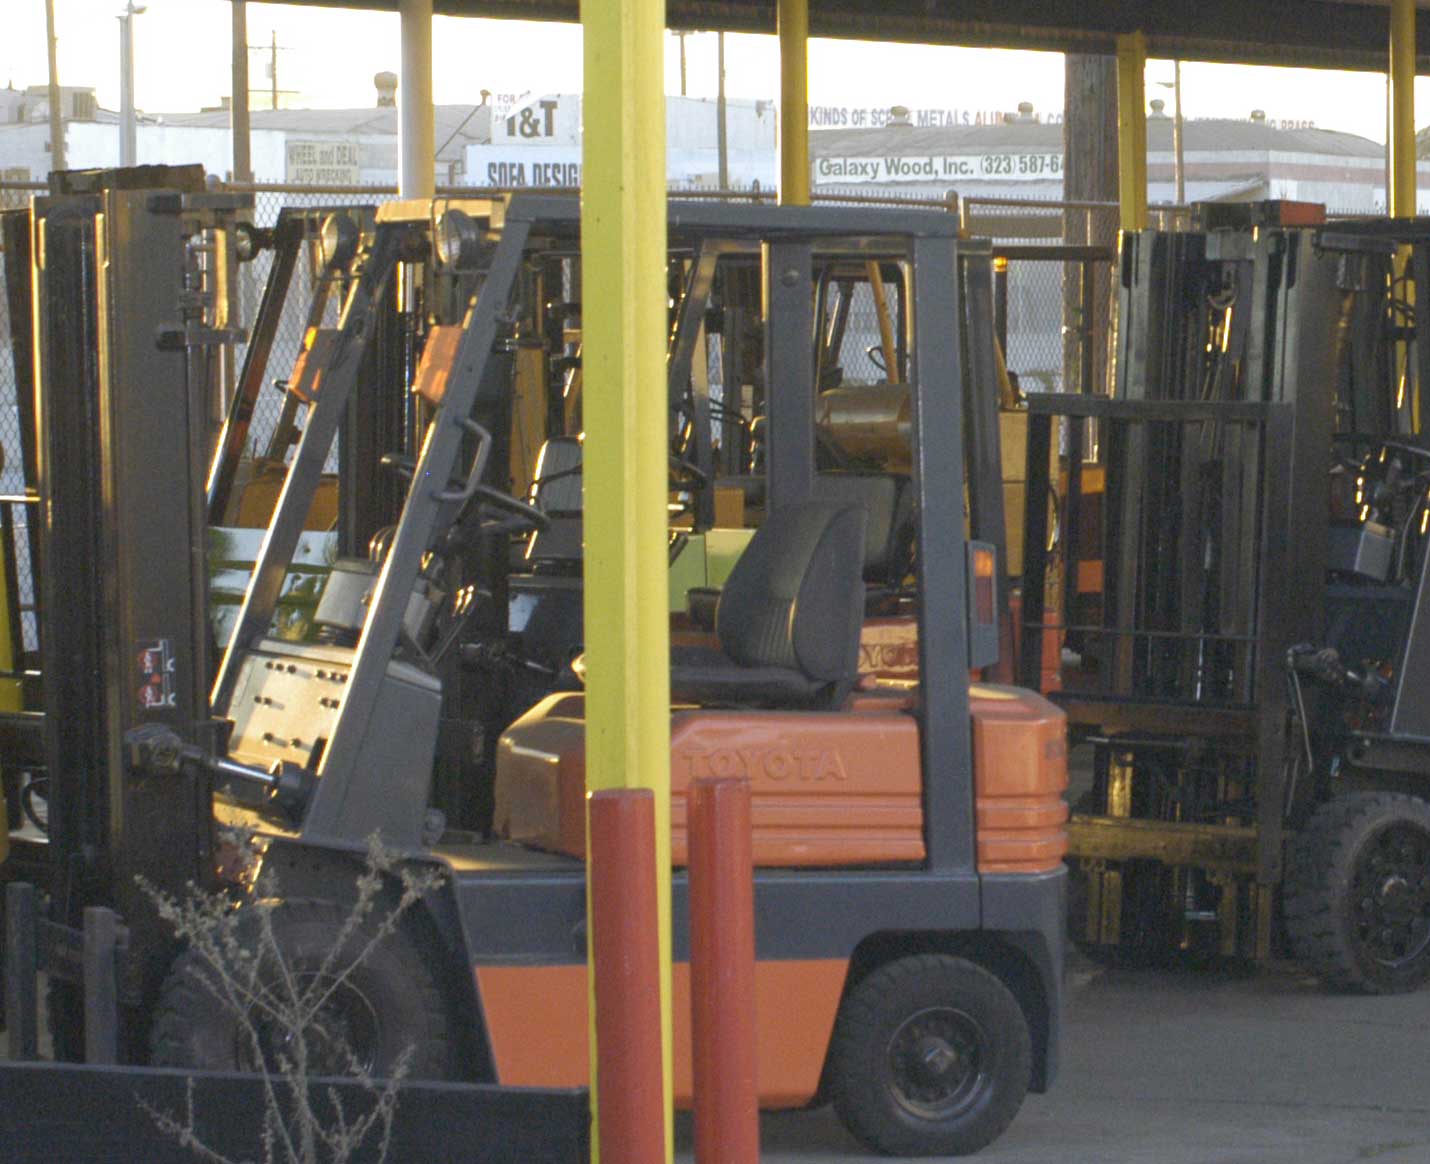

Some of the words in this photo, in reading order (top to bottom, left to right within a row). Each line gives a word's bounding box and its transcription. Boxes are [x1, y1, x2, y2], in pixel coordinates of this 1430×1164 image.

[810, 106, 848, 126] KINDS
[851, 108, 868, 126] OF
[871, 108, 910, 127] SCR
[916, 108, 970, 128] METALS
[487, 162, 526, 187] SOFA
[532, 163, 581, 187] DESIG
[819, 157, 880, 179] Galaxy
[884, 156, 939, 178] Wood,
[943, 156, 974, 175] Inc.
[980, 154, 1017, 175] (323)
[682, 750, 848, 781] TOYOTA
